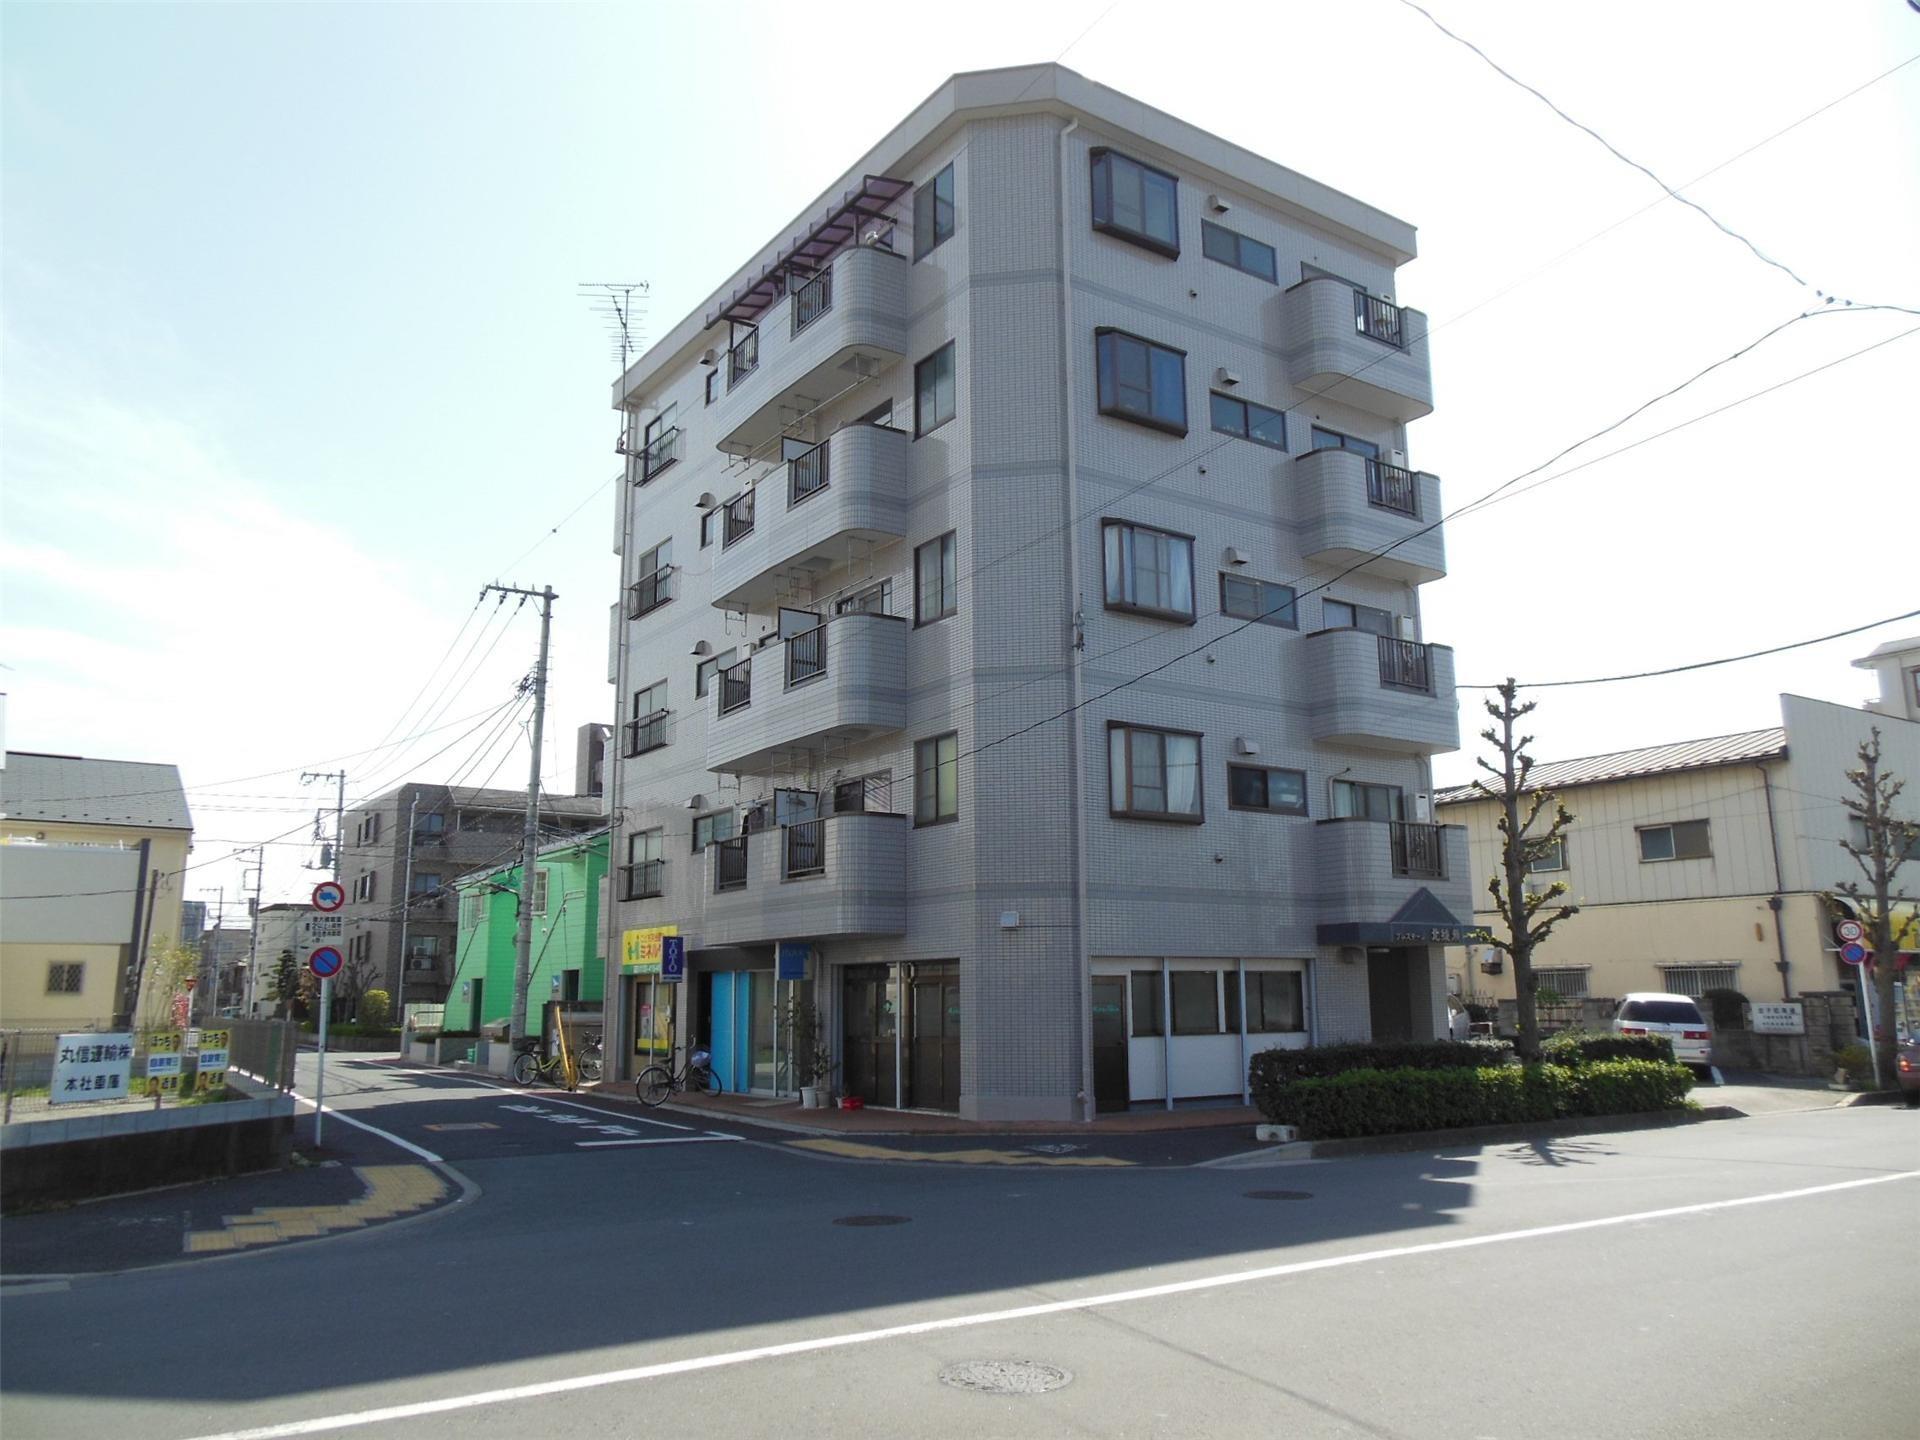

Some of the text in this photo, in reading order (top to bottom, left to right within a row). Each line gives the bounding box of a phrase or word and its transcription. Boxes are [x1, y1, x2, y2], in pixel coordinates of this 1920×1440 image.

[1842, 926, 1859, 936] 30
[668, 939, 678, 973] TOTO
[59, 1043, 130, 1064] 丸信運輸株
[64, 1073, 121, 1092] 本社車庫
